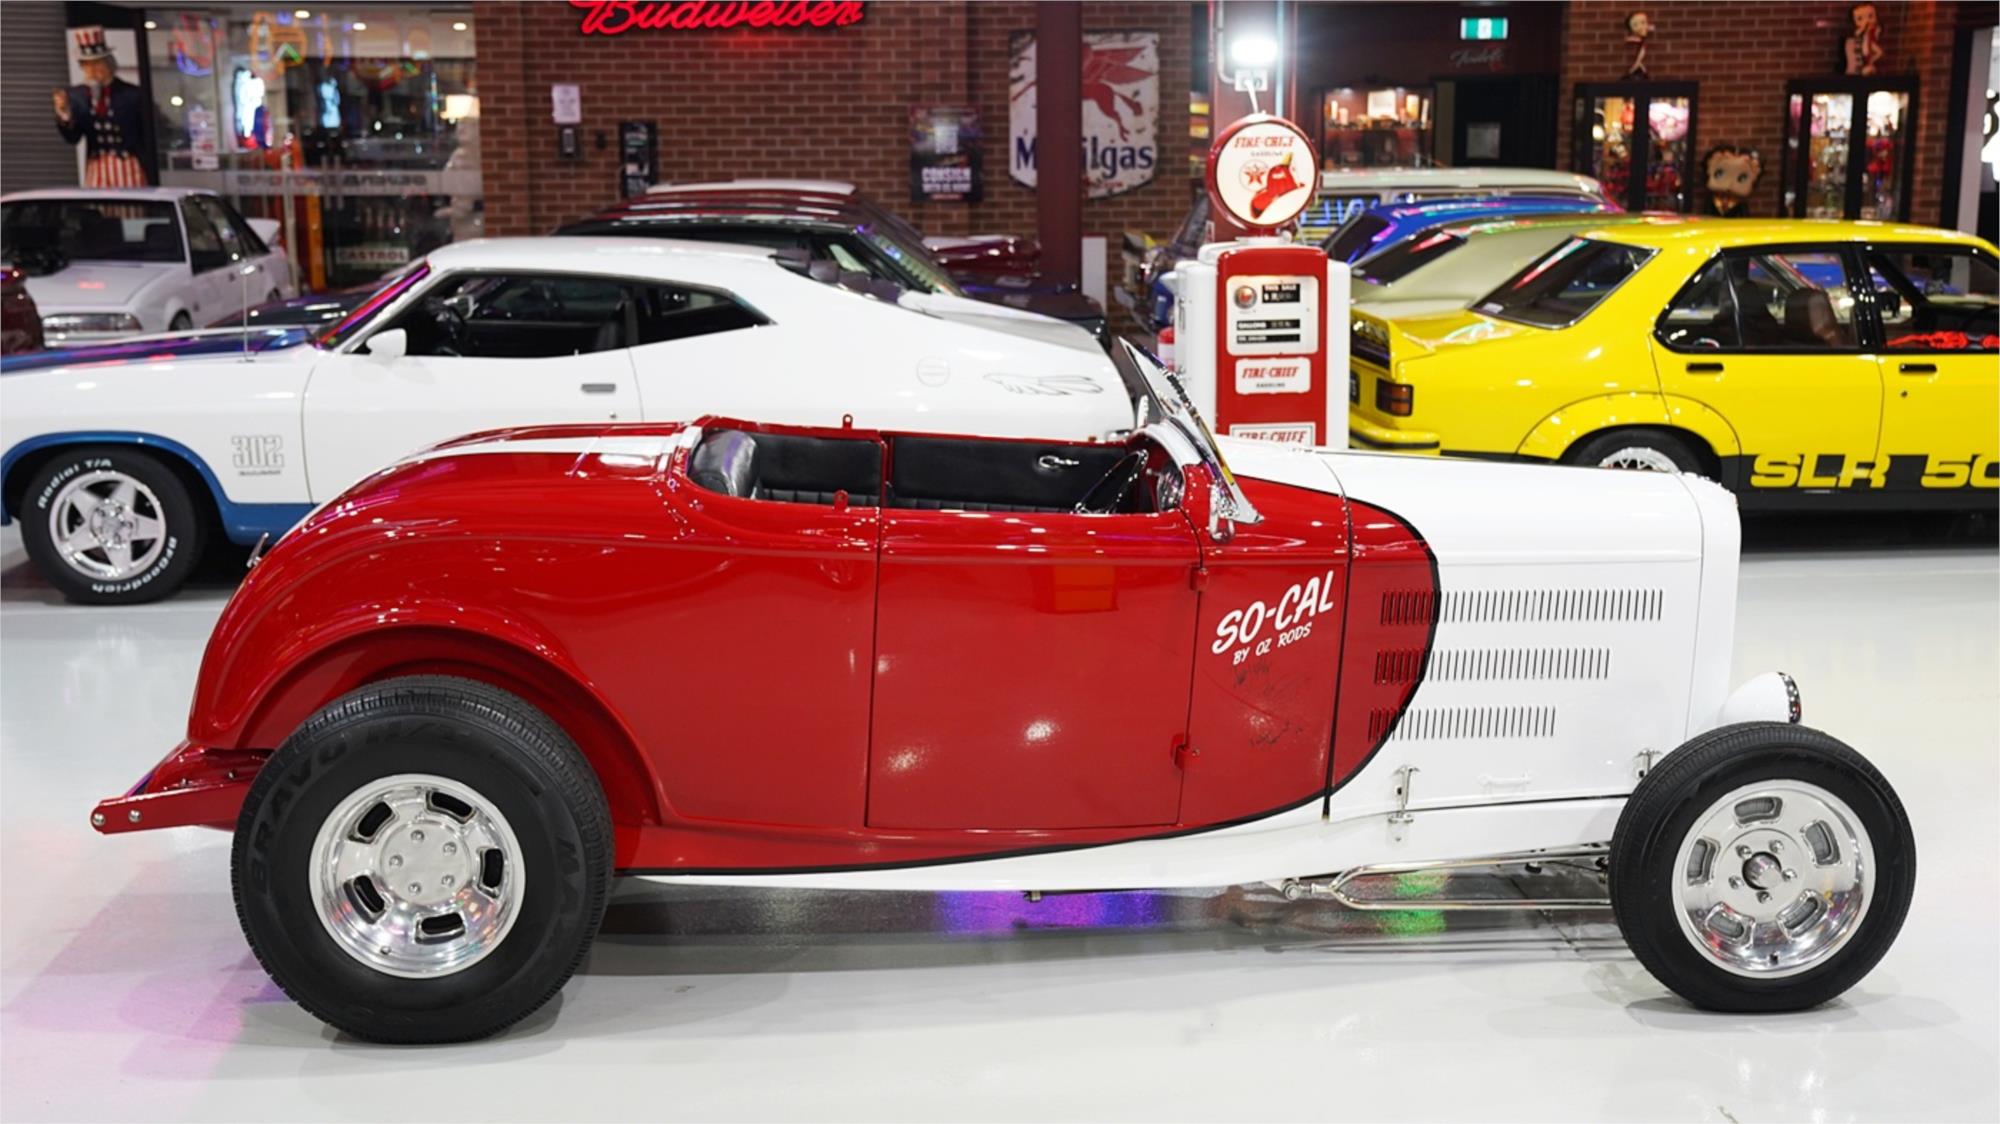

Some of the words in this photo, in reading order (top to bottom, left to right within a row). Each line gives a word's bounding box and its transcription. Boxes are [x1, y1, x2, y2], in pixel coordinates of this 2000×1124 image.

[569, 1, 863, 35] Budweiser
[1016, 136, 1154, 179] Milgas
[1242, 367, 1299, 379] FIRE-CHIEF
[231, 434, 285, 469] 302
[1750, 454, 1891, 488] SLR
[37, 463, 80, 509] Radial
[84, 458, 113, 469] T/A
[1211, 569, 1334, 655] SO-CAL
[1233, 646, 1251, 666] BY
[1255, 638, 1273, 657] OZ
[1276, 621, 1313, 648] RODS
